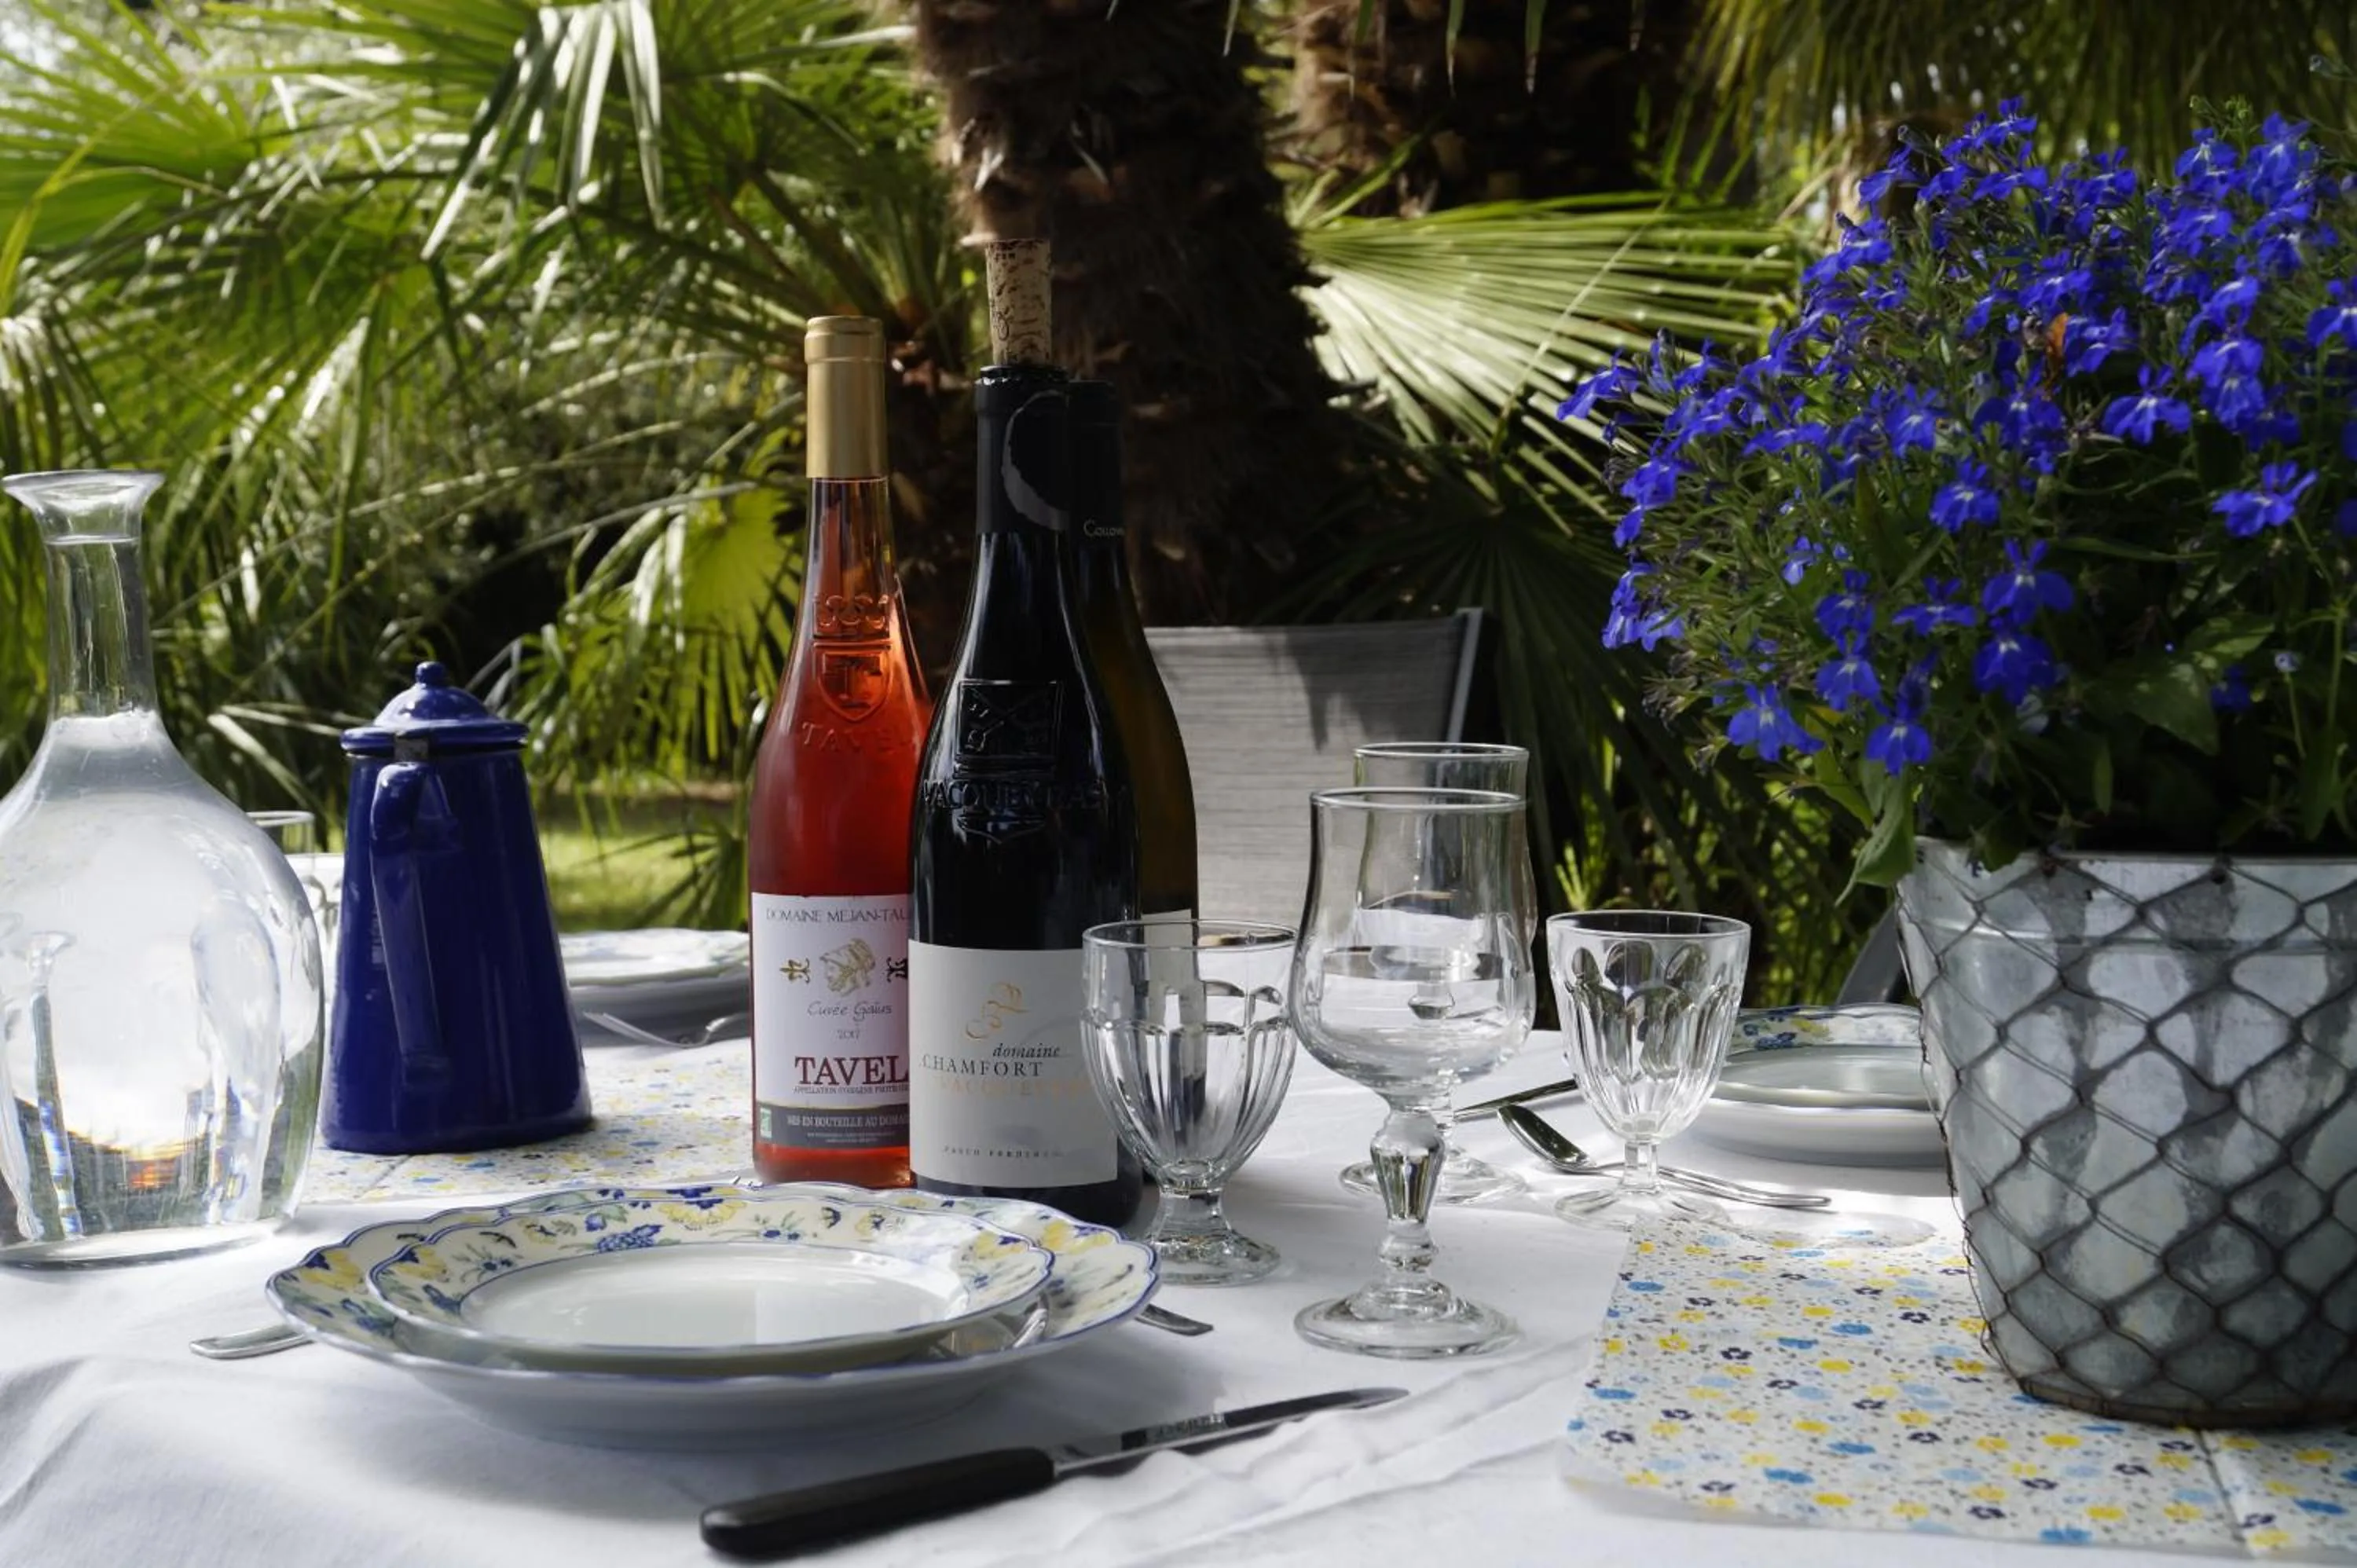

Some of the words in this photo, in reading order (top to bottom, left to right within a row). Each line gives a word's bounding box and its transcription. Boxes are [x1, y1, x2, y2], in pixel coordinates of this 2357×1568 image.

[766, 908, 823, 923] DOMAINE
[992, 1043, 1060, 1058] domaine
[795, 1056, 908, 1086] TAVEL
[919, 1054, 1043, 1077] CHAMFORT
[865, 1116, 878, 1127] AU
